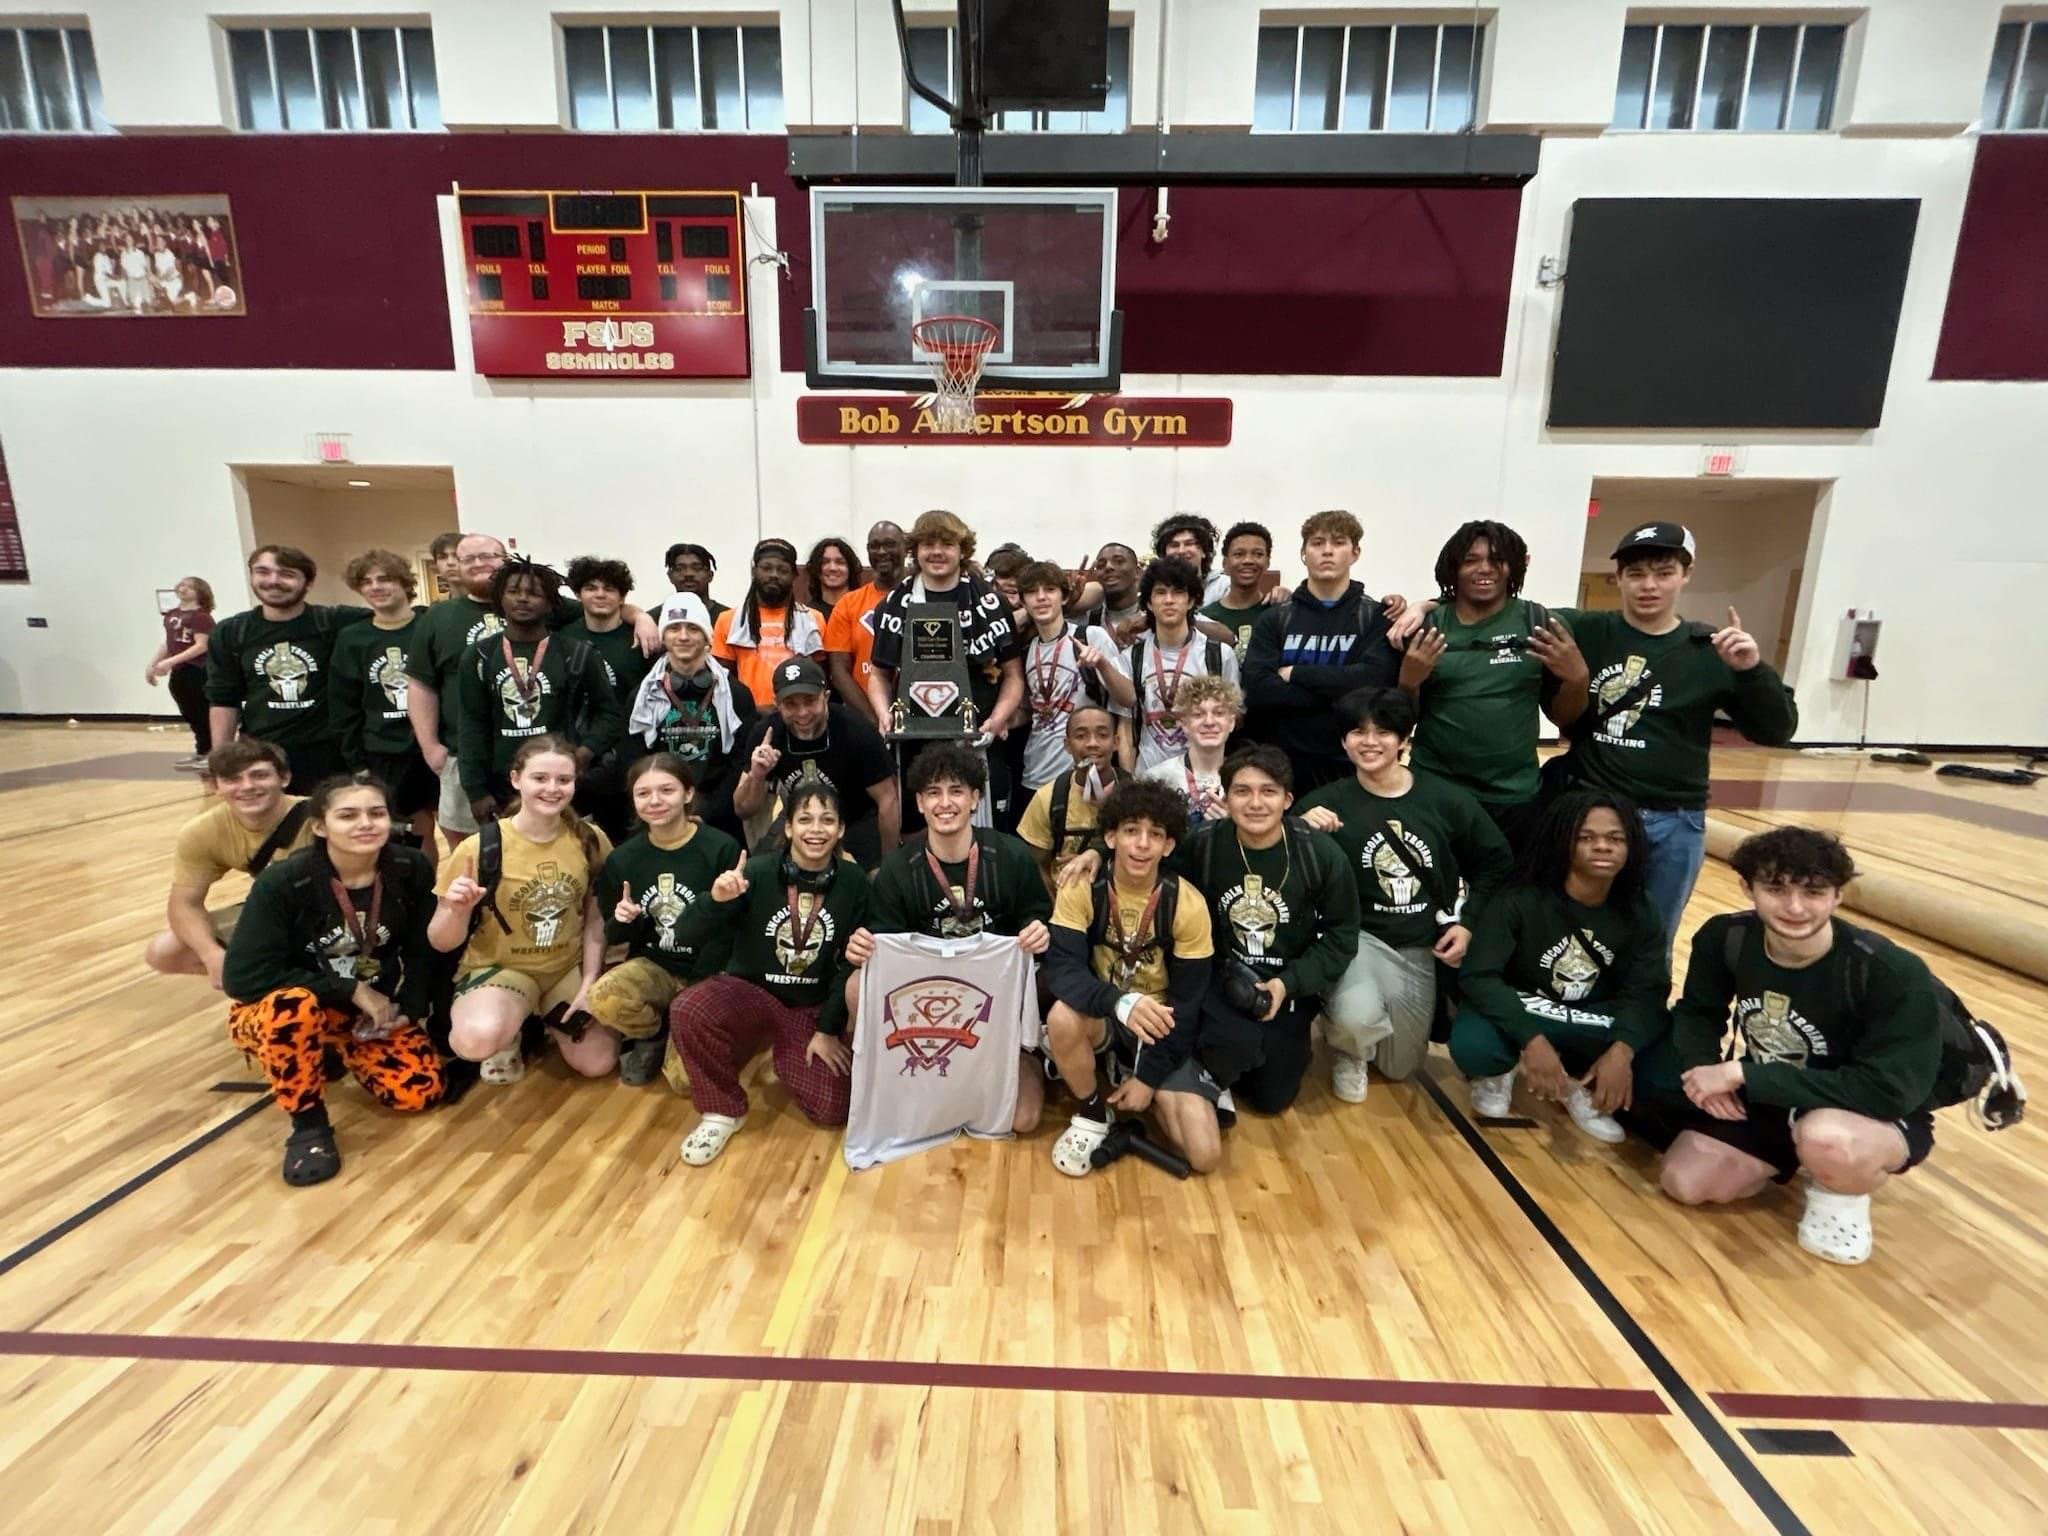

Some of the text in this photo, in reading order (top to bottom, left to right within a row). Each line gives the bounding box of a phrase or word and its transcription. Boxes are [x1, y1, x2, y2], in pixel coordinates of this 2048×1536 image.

[576, 244, 606, 255] PERIOD
[475, 263, 502, 274] FOULS
[576, 264, 632, 274] PLAYER FOUL
[704, 264, 731, 274] FOULS
[591, 301, 620, 310] MATCH
[562, 320, 655, 348] FSUS
[546, 352, 674, 370] SEMINOLES
[838, 406, 899, 434] Bob
[1103, 407, 1187, 441] Gym
[1283, 634, 1357, 665] NAVY
[1589, 663, 1624, 694] LINCOLN
[501, 725, 547, 737] WRESTLING
[1362, 832, 1386, 869] LINCOLN
[1539, 936, 1570, 969] LINCOLN
[765, 973, 820, 985] WRESTLING
[1788, 1009, 1829, 1056] TROJANS
